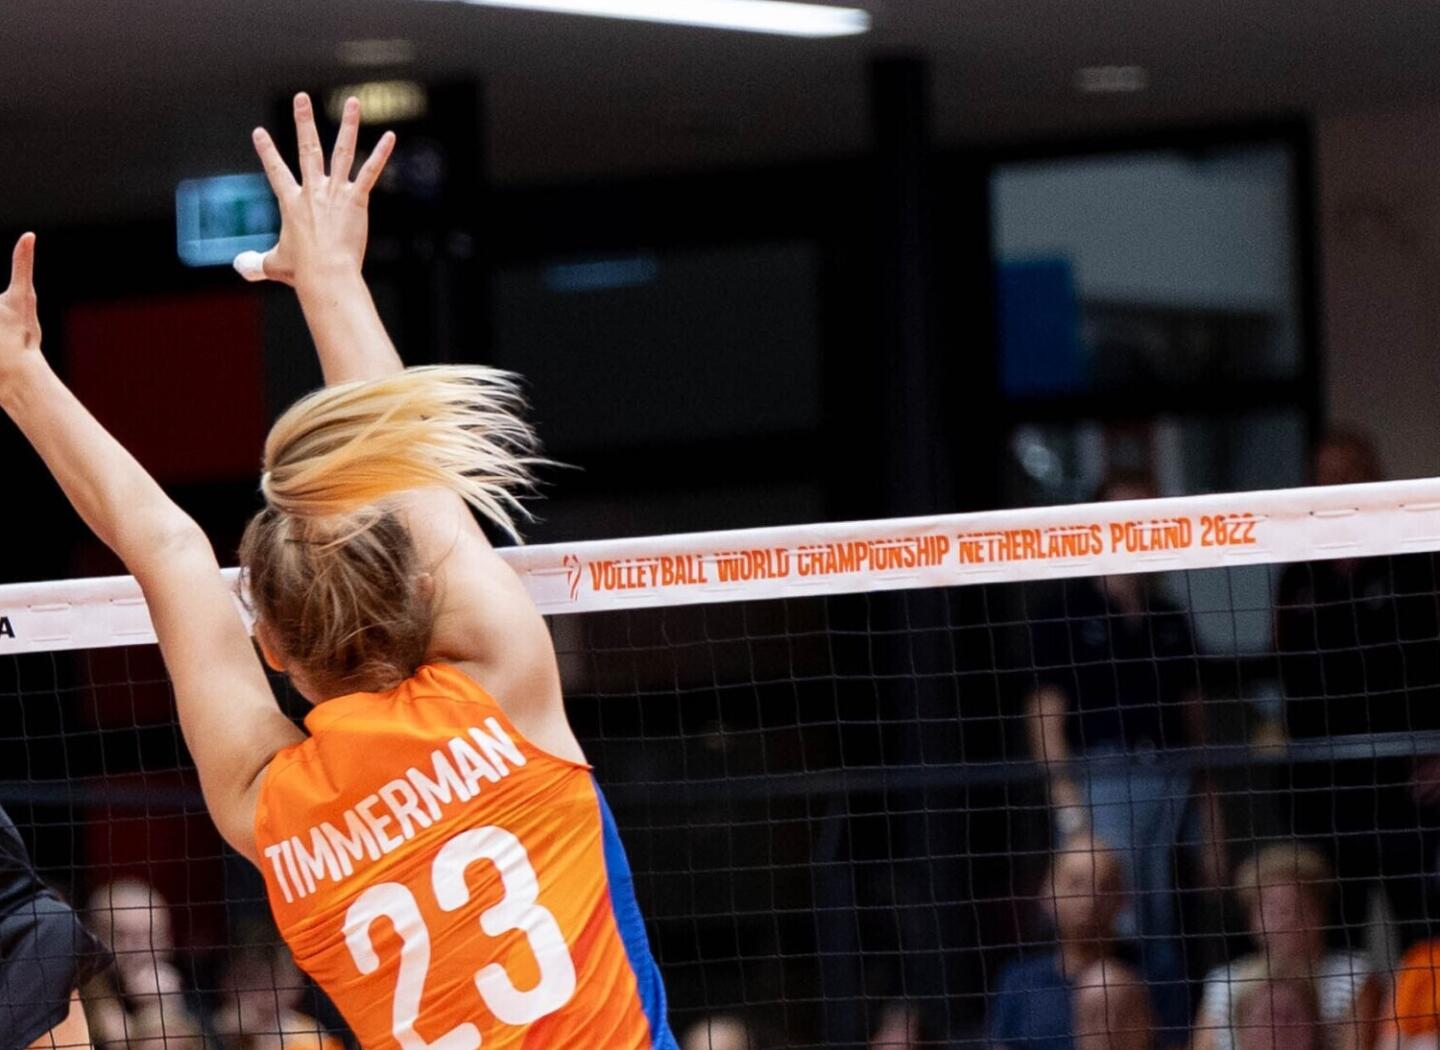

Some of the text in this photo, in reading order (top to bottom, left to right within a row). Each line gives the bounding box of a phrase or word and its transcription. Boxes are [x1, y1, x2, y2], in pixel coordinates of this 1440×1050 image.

[588, 512, 1257, 591] VOLLEYBALL WORLD CHAMPIONSHIP NETHERLANDS POLAND 2022
[264, 716, 527, 903] TIMMERMAN
[340, 825, 576, 1050] 23
